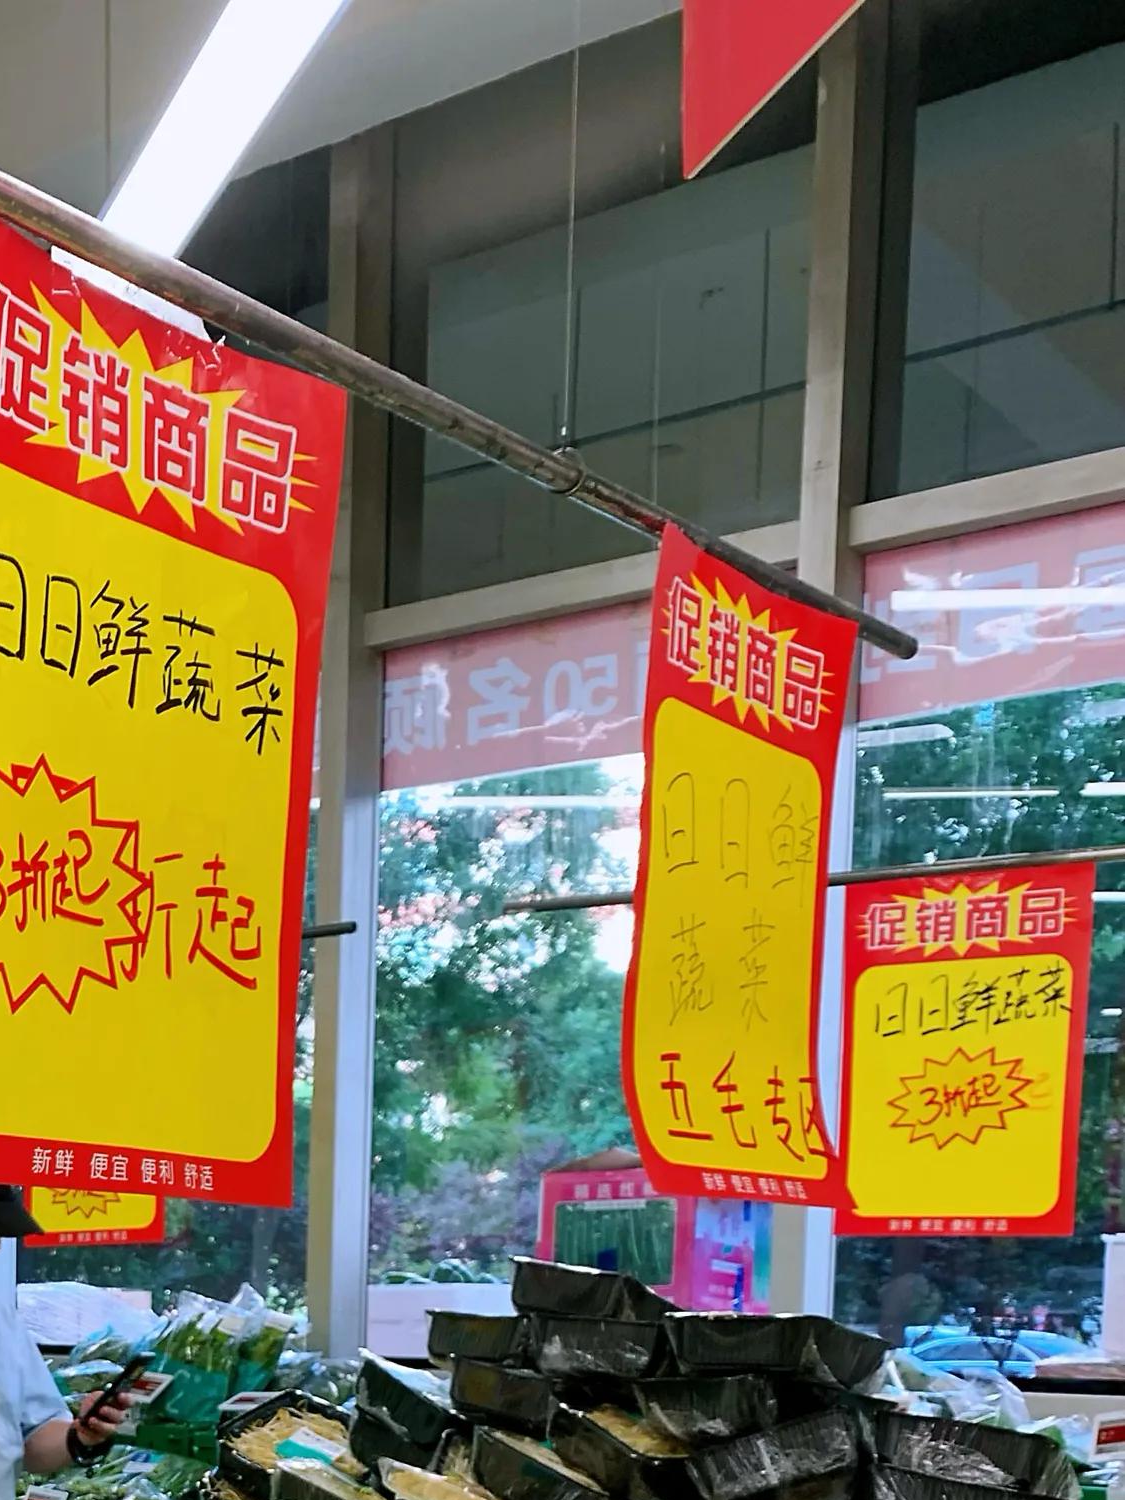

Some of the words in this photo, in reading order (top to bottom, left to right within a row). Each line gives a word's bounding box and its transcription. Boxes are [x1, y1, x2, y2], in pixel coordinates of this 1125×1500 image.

[666, 575, 825, 731] 促销商品
[864, 887, 1066, 951] 促销商品
[875, 959, 1074, 1037] 日日鲜蔬菜
[31, 1147, 75, 1177] 新鲜
[89, 1151, 130, 1183] 便宜
[141, 1156, 175, 1187] 便利
[183, 1164, 215, 1192] 舒适
